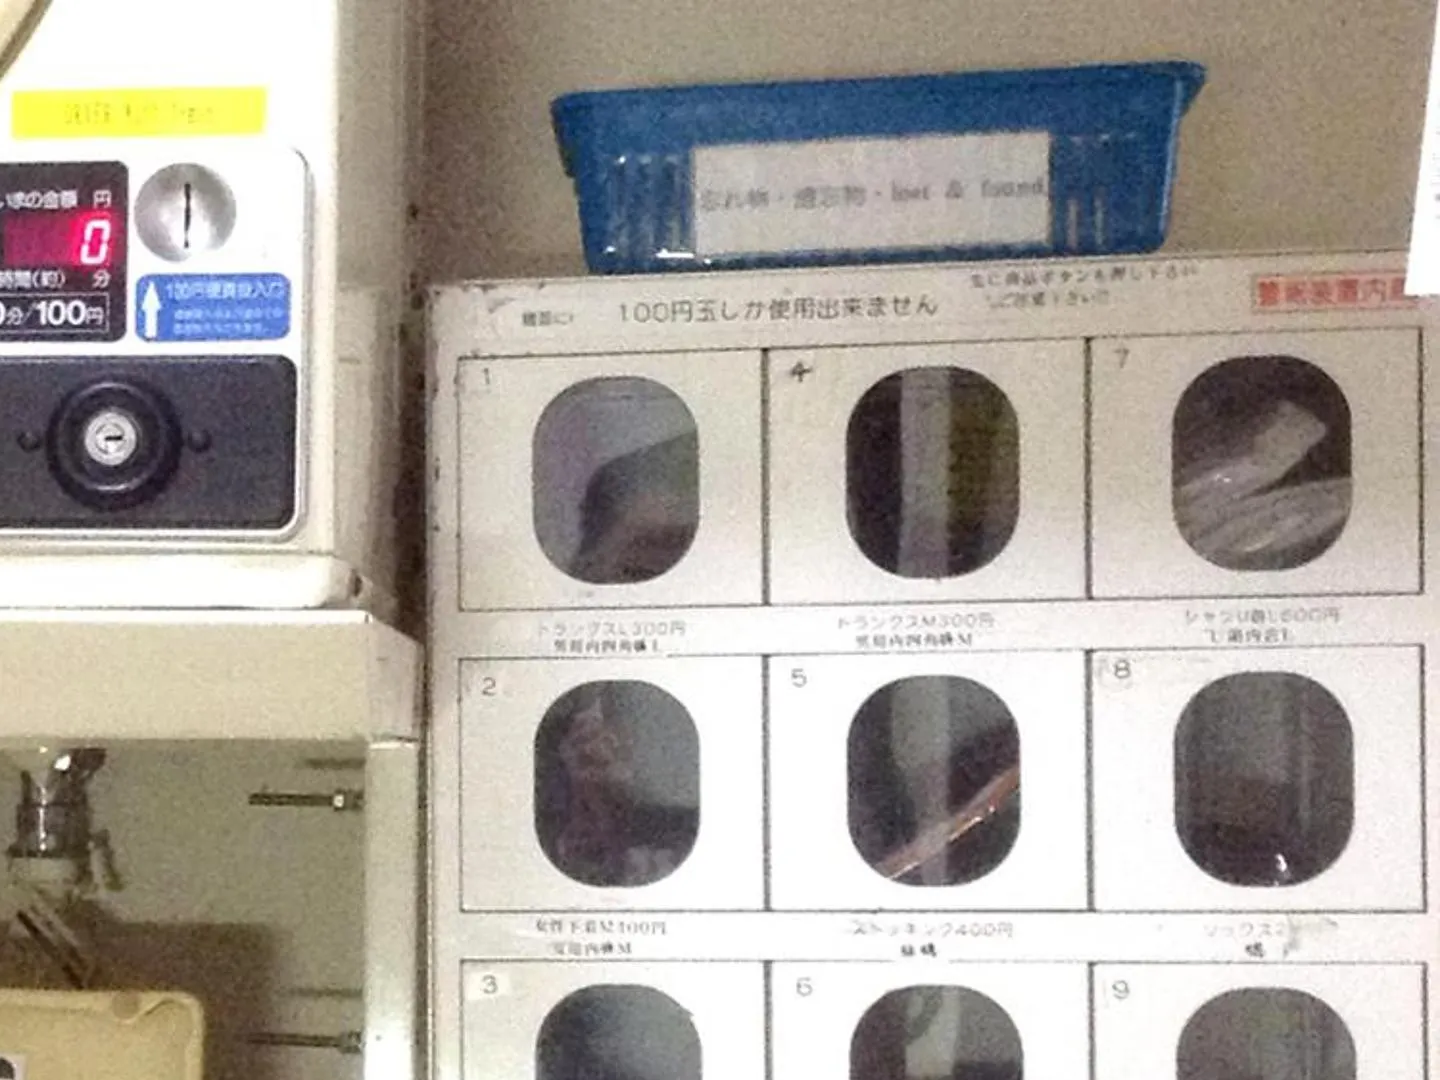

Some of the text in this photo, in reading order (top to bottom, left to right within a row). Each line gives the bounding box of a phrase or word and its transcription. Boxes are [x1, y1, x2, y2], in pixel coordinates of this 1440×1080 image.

[92, 190, 111, 209] 円
[80, 219, 111, 265] 0
[92, 269, 111, 289] 分
[617, 292, 938, 324] 100円玉しか使用出来ません
[790, 669, 808, 687] 5
[1113, 659, 1132, 679] 8
[481, 676, 498, 697] 2
[481, 975, 498, 994] 3
